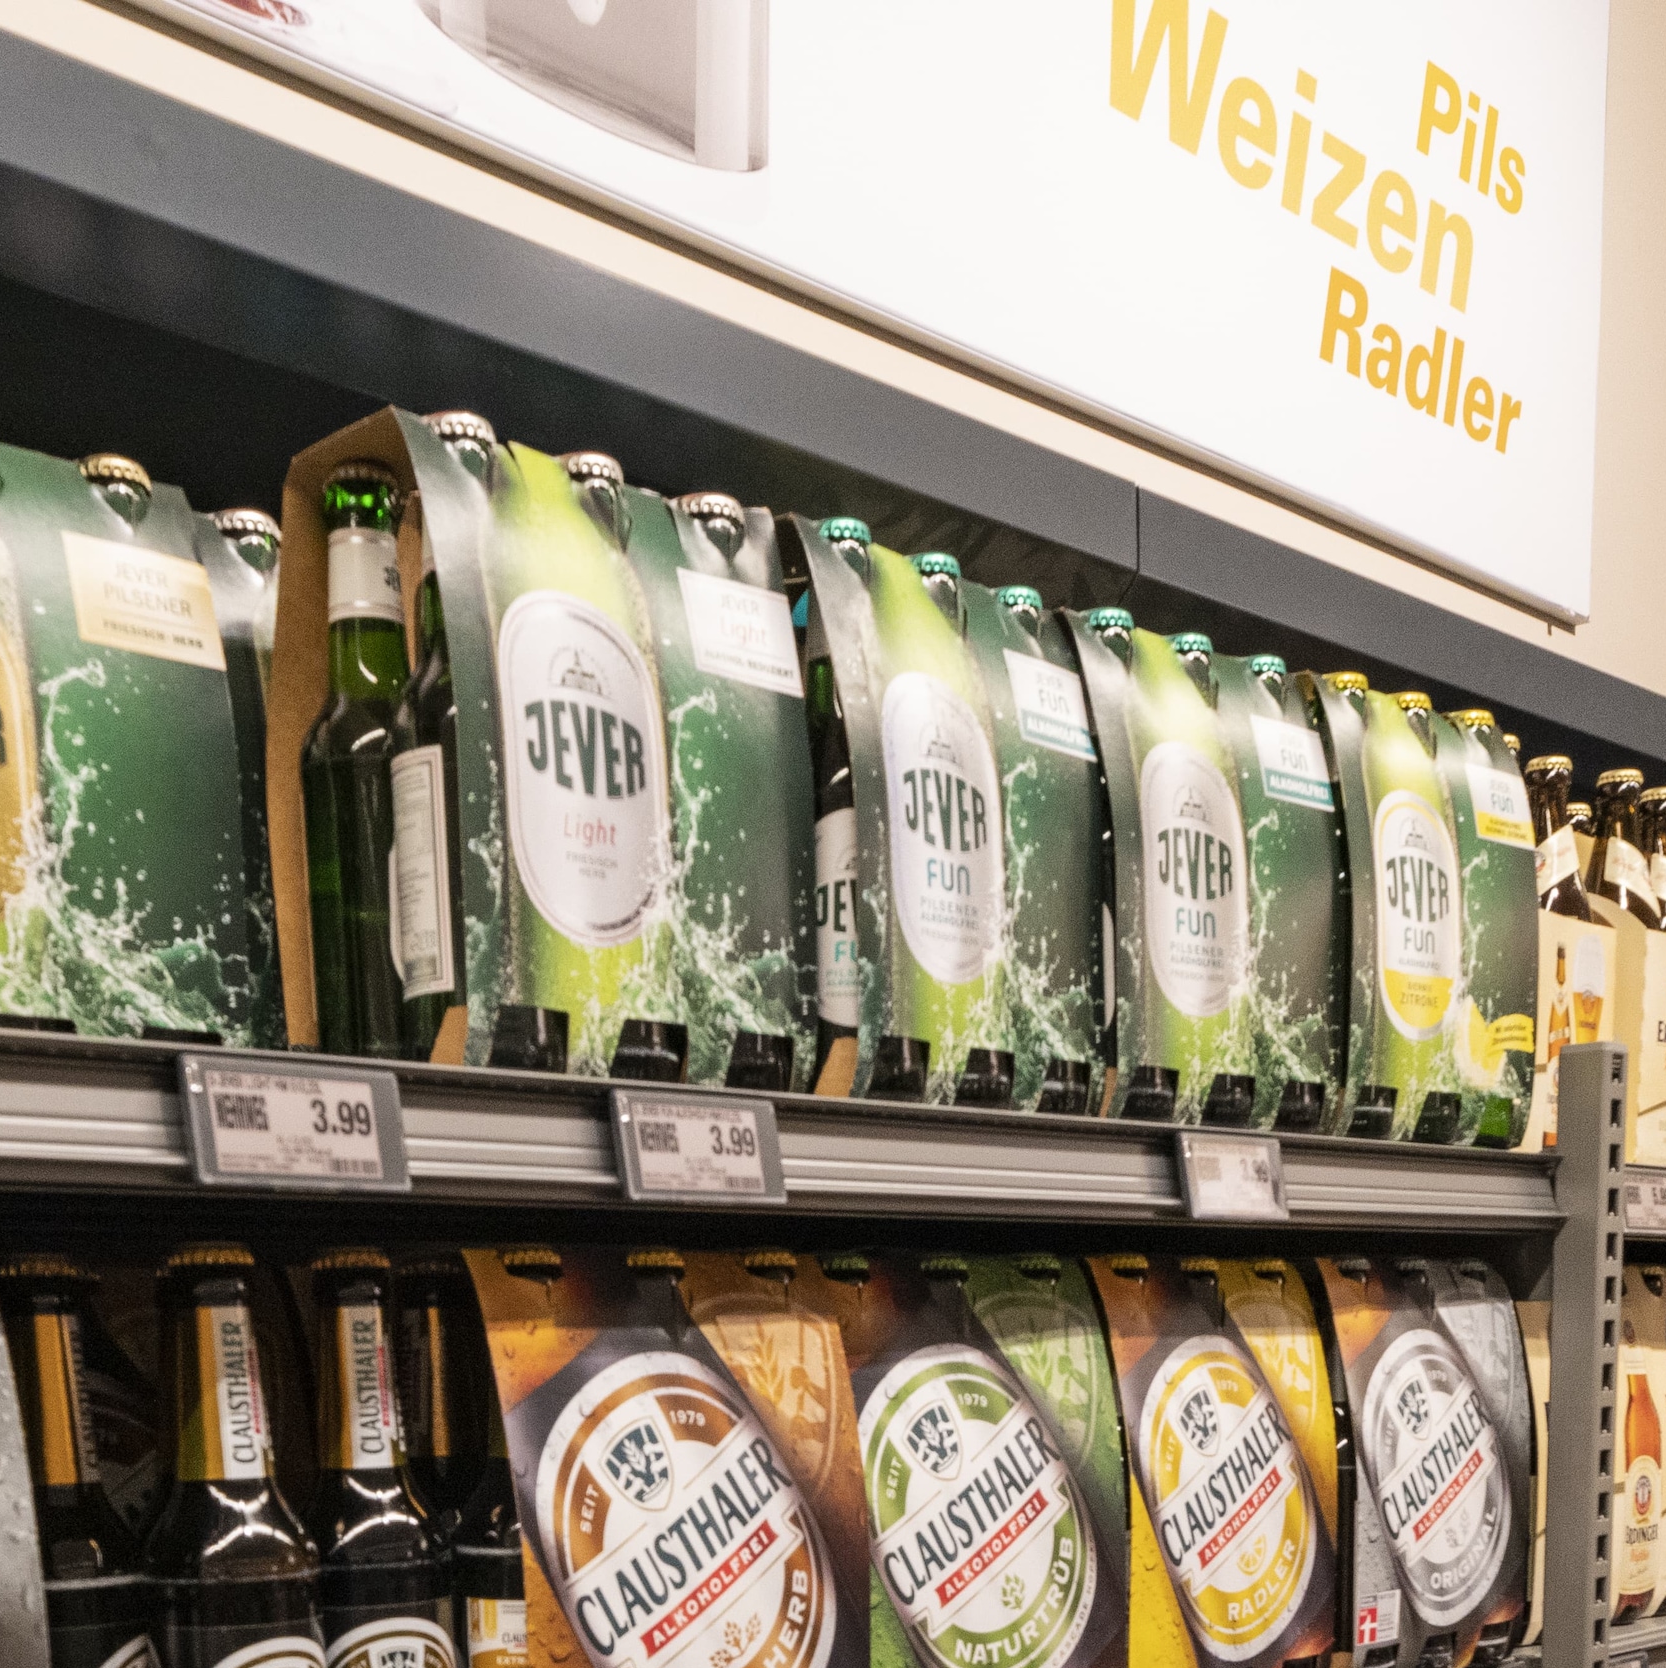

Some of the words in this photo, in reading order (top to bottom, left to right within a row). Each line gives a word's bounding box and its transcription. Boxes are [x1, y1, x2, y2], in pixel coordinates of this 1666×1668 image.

[1109, 0, 1474, 314] Weizen
[1416, 60, 1526, 215] Pils
[1319, 265, 1522, 455] Radler
[101, 581, 193, 621] PILSENER
[113, 561, 171, 591] JEVER
[718, 610, 770, 650] Light
[1037, 688, 1071, 715] FUN
[524, 699, 647, 800] JEVER
[1280, 746, 1310, 772] FUN
[562, 812, 618, 850] Light
[902, 767, 988, 852] JEVER
[1489, 794, 1515, 815] FUN
[926, 856, 972, 897] FUN
[1157, 827, 1233, 900] JEVER
[1386, 855, 1450, 923] JEVER
[1175, 906, 1217, 940] FUN
[1403, 926, 1436, 954] FUN
[310, 1098, 372, 1137] 3.99
[709, 1124, 757, 1158] 3.99
[220, 1320, 257, 1465] CLAUSTHALER
[351, 1318, 386, 1456] CLAUSTHALER
[669, 1409, 708, 1428] 1979
[957, 1393, 989, 1408] 1979
[580, 1482, 600, 1536] SEIT
[885, 1456, 903, 1500] SEIT
[1159, 1401, 1291, 1568] CLAUSTHALER
[1381, 1398, 1493, 1542] CLAUSTHALER
[1414, 1453, 1483, 1539] ALKOHOLFREI
[576, 1438, 792, 1657] CLAUSTHALER
[883, 1415, 1063, 1607] CLAUSTHALER
[942, 1499, 1043, 1599] ALKOHOLFREI
[1200, 1469, 1280, 1565] ALKOHOLFREI
[1429, 1505, 1498, 1591] ORIGINAL
[651, 1526, 772, 1644] ALKOHOLFREI
[953, 1534, 1076, 1666] NATURTRÜB
[1227, 1536, 1298, 1622] RADLER
